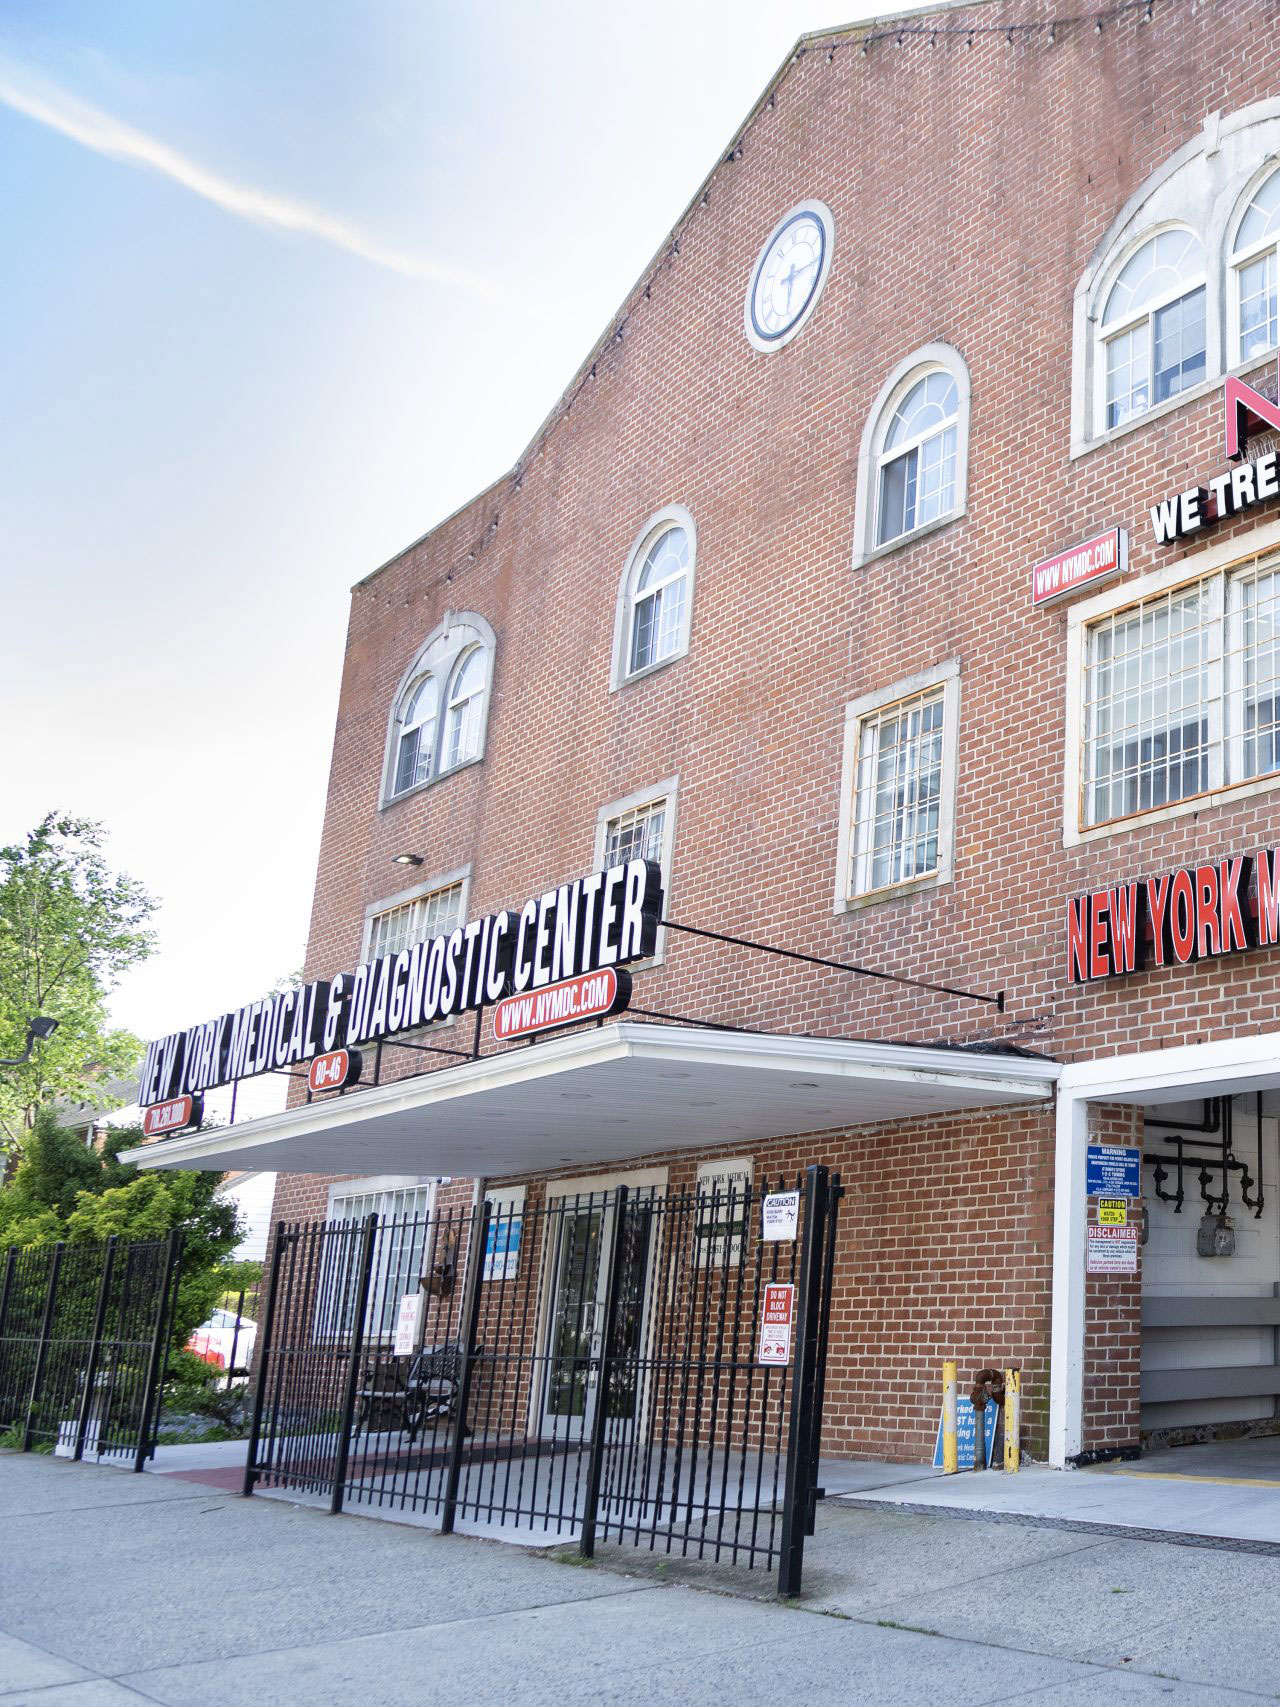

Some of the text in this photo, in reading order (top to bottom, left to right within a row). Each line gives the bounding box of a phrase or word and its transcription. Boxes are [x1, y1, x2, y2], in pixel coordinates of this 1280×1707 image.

[1150, 486, 1201, 545] WE
[1067, 882, 1138, 984] NEW
[1146, 855, 1248, 967] YORK
[138, 858, 648, 1107] NEW YORK MEDICAL & DIAGNOSTIC CENTER
[501, 975, 609, 1034] WWW.NYMDC.COM
[315, 1056, 341, 1085] 80-46
[1102, 1148, 1126, 1156] WARNING
[767, 1197, 795, 1207] CAUTION
[1101, 1200, 1125, 1208] CAUTION
[1088, 1228, 1136, 1239] DISCLAIMER
[771, 1290, 787, 1299] DO NOT
[770, 1301, 785, 1310] BLOCK
[766, 1312, 788, 1321] DRIVEWAY
[957, 1416, 966, 1425] ST
